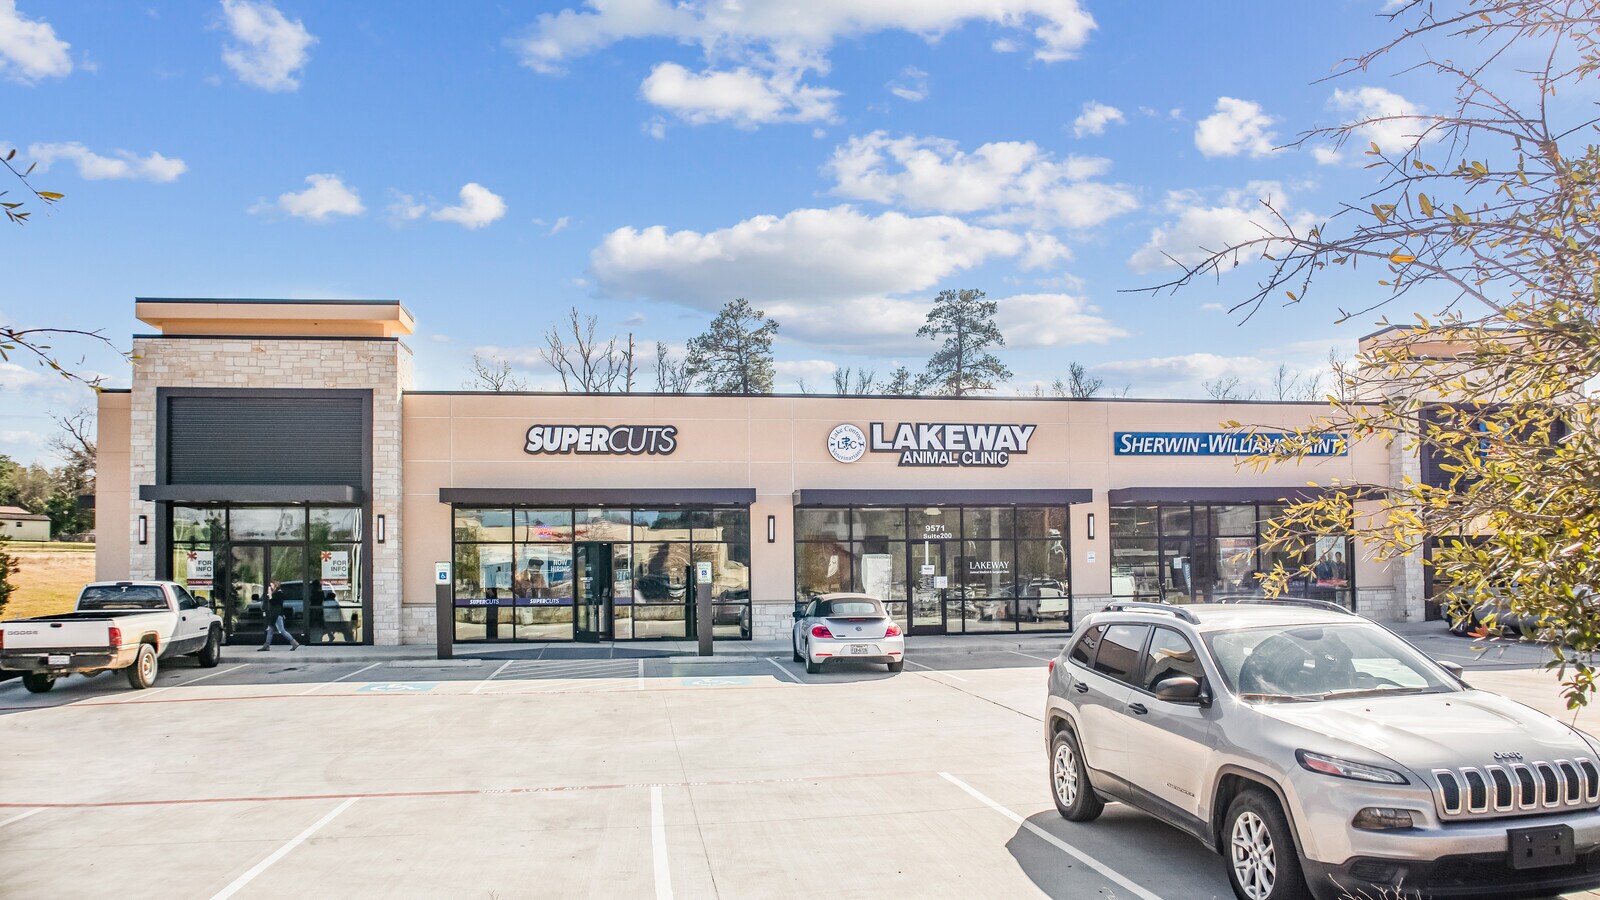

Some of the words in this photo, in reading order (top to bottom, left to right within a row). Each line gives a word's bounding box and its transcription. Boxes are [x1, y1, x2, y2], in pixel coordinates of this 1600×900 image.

[526, 426, 676, 452] SUPERCUTS
[830, 428, 843, 441] Lake
[871, 423, 1036, 451] LAKEWAY
[1295, 434, 1347, 454] AINT
[901, 451, 958, 464] ANIMAL
[961, 451, 1008, 465] CLINIC
[925, 524, 945, 532] 9571
[969, 561, 1009, 570] LAKEWAY
[1493, 750, 1523, 760] Jeep
